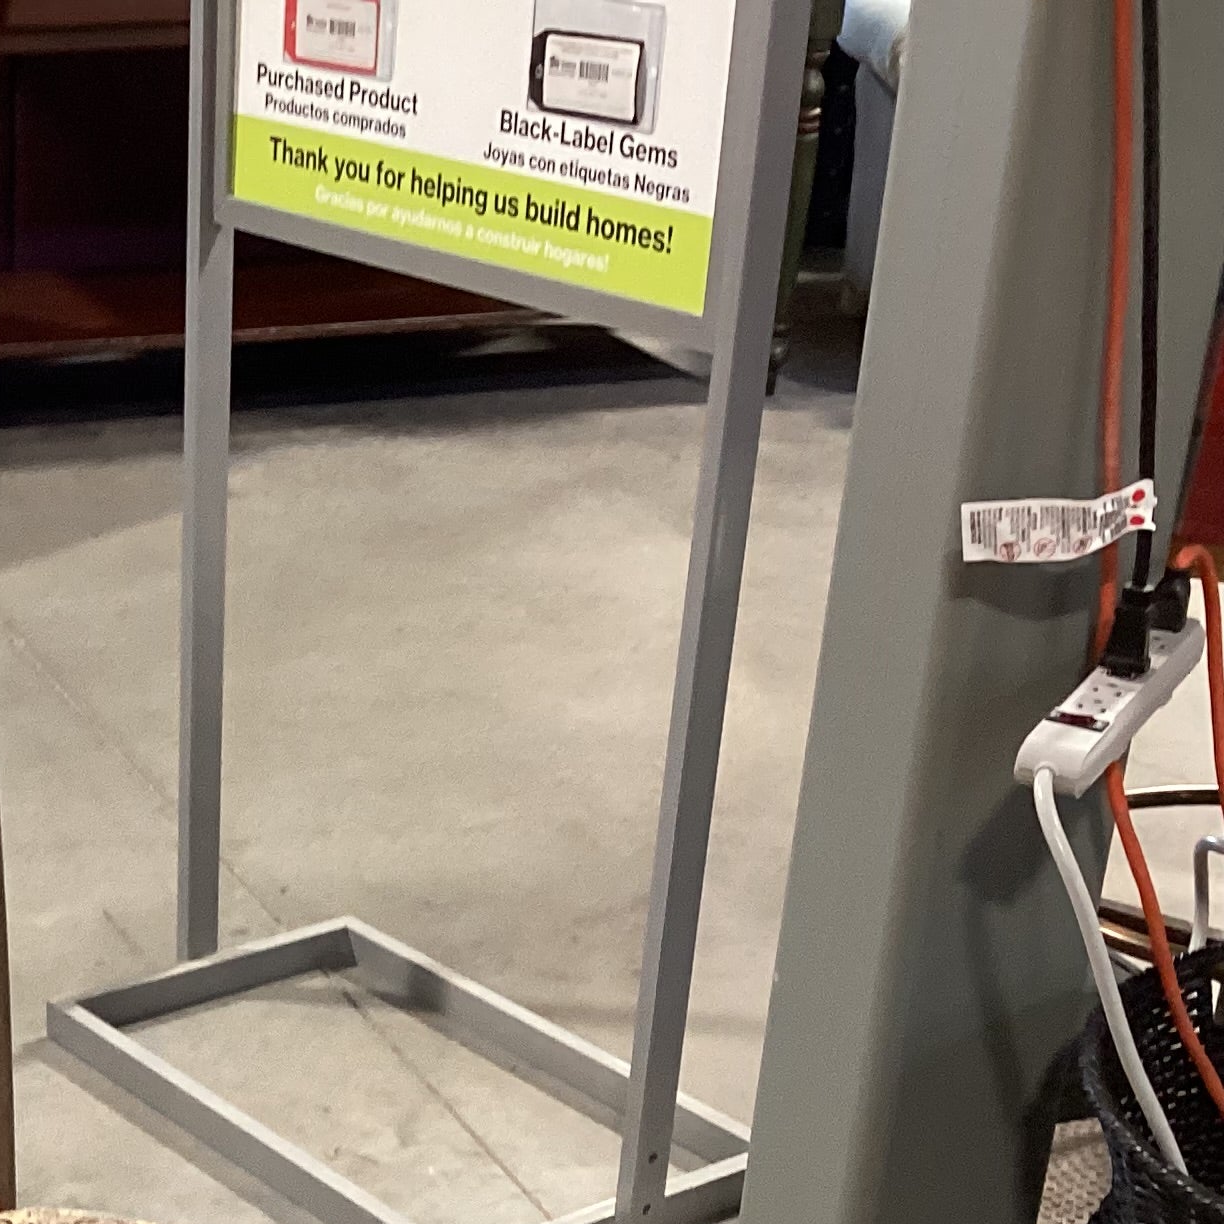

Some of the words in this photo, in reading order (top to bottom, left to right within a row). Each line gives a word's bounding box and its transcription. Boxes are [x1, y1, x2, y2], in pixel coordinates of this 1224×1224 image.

[256, 62, 345, 100] Purchased
[349, 80, 418, 116] Product
[265, 93, 329, 122] Productos
[332, 110, 407, 139] comprados
[499, 109, 614, 155] Black-Label
[619, 133, 678, 169] Gems
[269, 136, 329, 174] Thank
[334, 157, 370, 183] you
[377, 160, 406, 191] for
[410, 167, 488, 216] helping
[494, 193, 519, 217] us
[525, 192, 581, 233] build
[586, 207, 674, 254] homes!
[483, 142, 525, 168] Joyas
[529, 154, 556, 174] con
[559, 160, 630, 190] etiquetas
[633, 173, 690, 203] Negras
